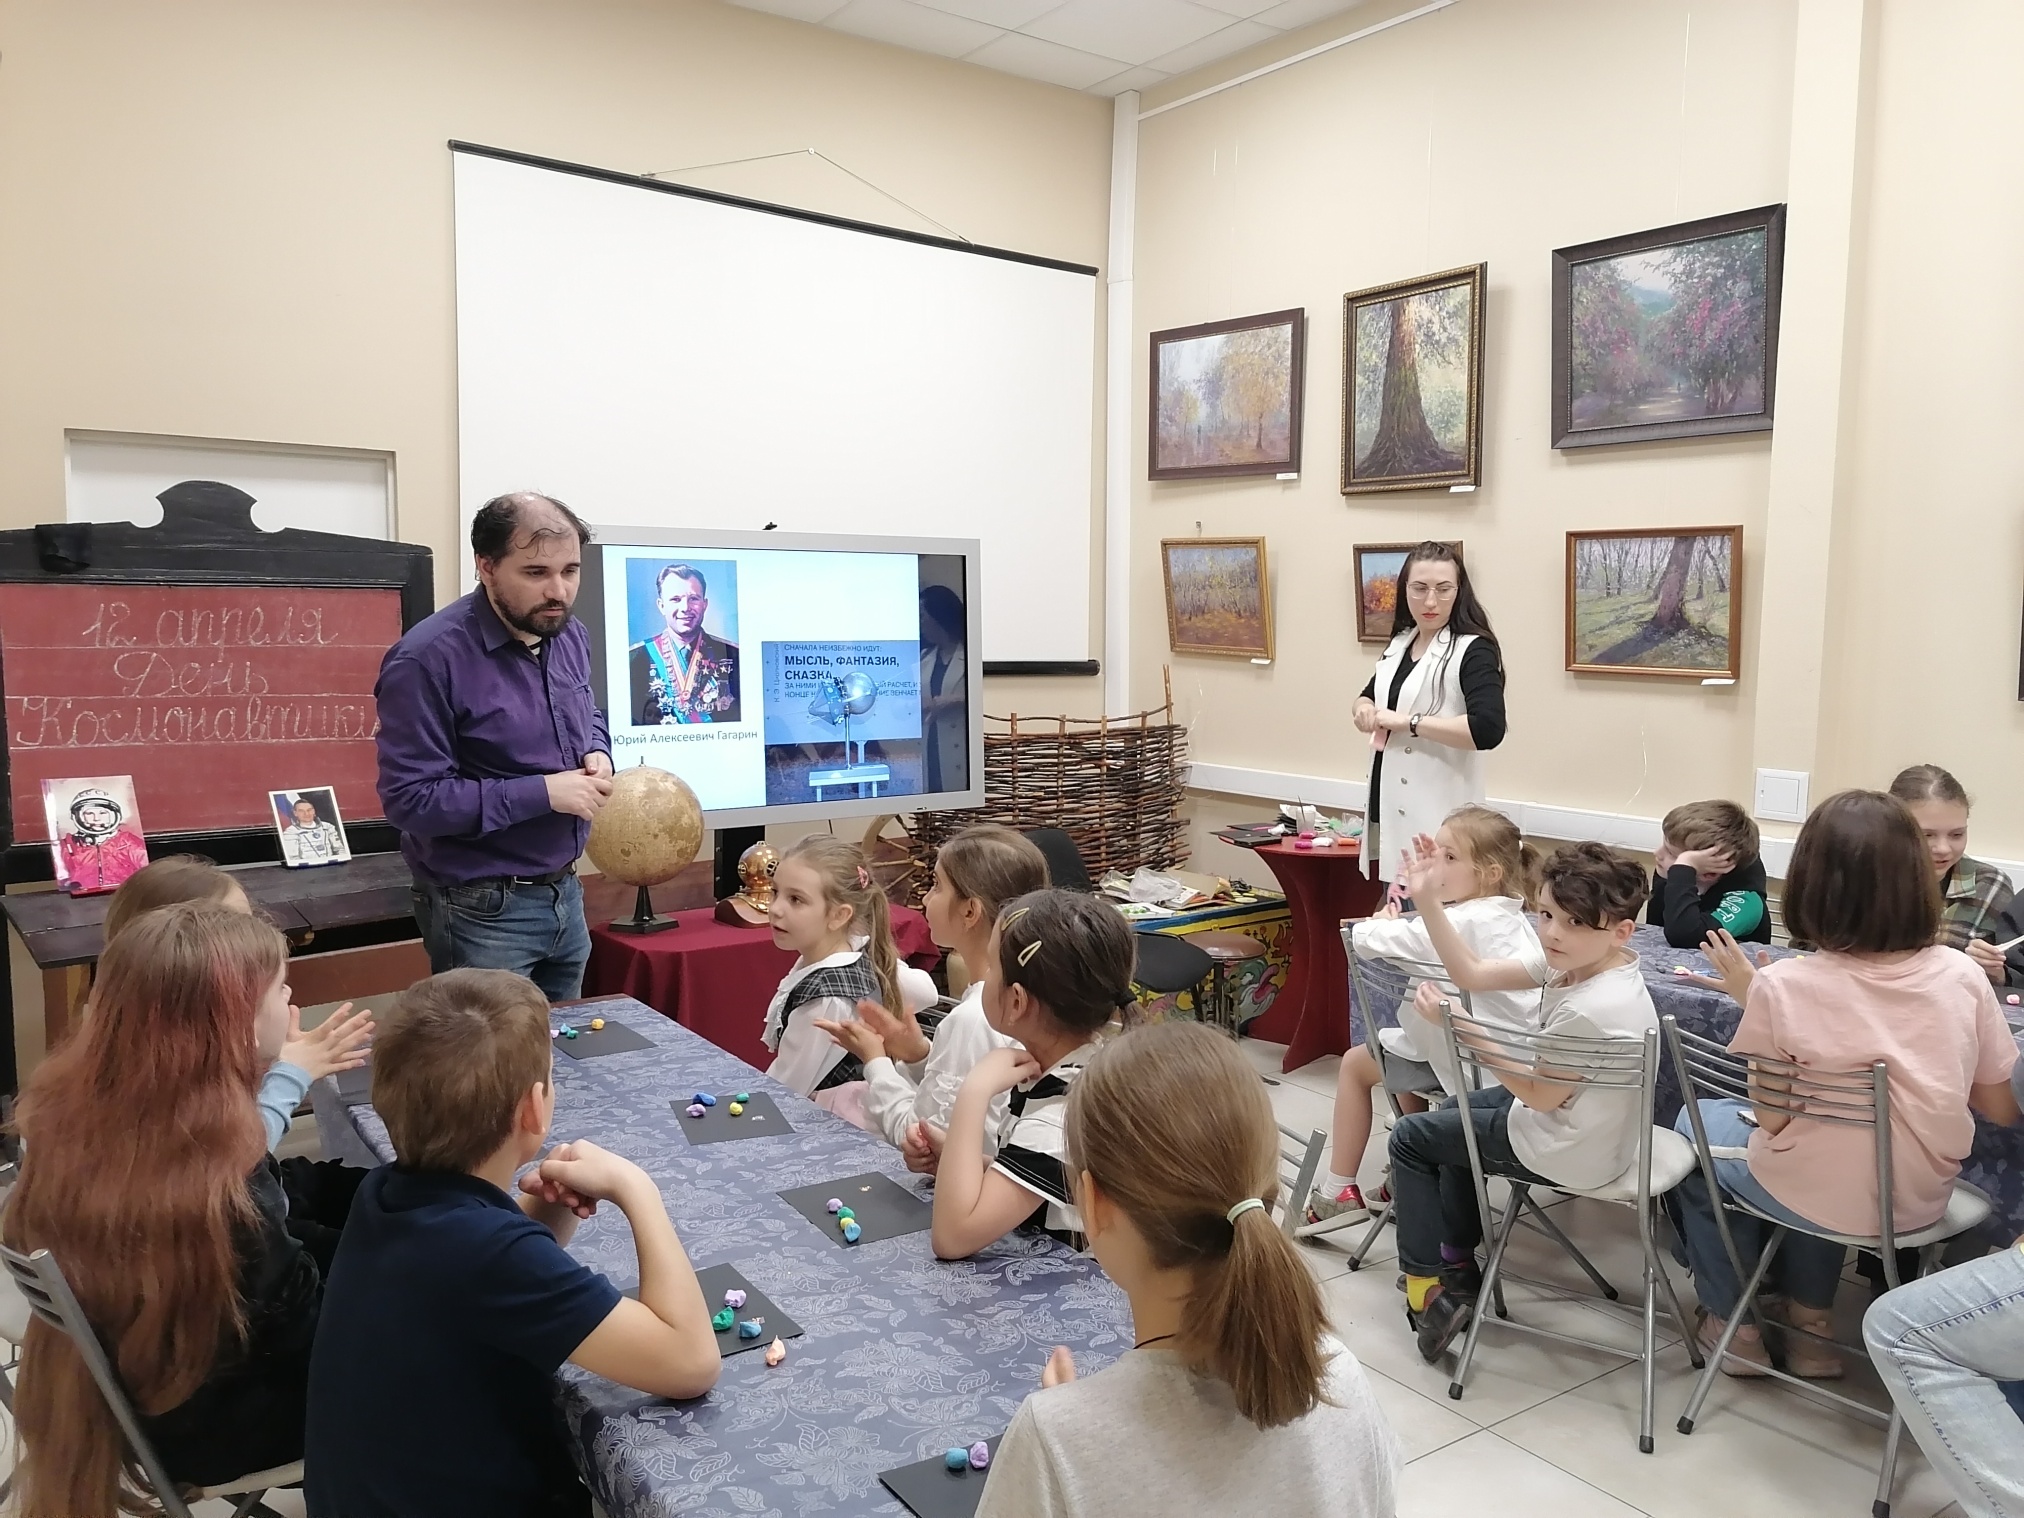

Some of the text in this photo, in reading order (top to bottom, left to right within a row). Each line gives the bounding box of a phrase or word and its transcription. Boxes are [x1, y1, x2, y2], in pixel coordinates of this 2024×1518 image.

[82, 602, 338, 662] 12 апреля
[819, 644, 862, 652] НЕИЗБЕЖНО
[784, 655, 900, 668] МЫСЛЬ, ФАНТАЗИЯ,
[113, 651, 269, 697] День
[613, 730, 758, 746] Юрий Алексеевич Гагарин
